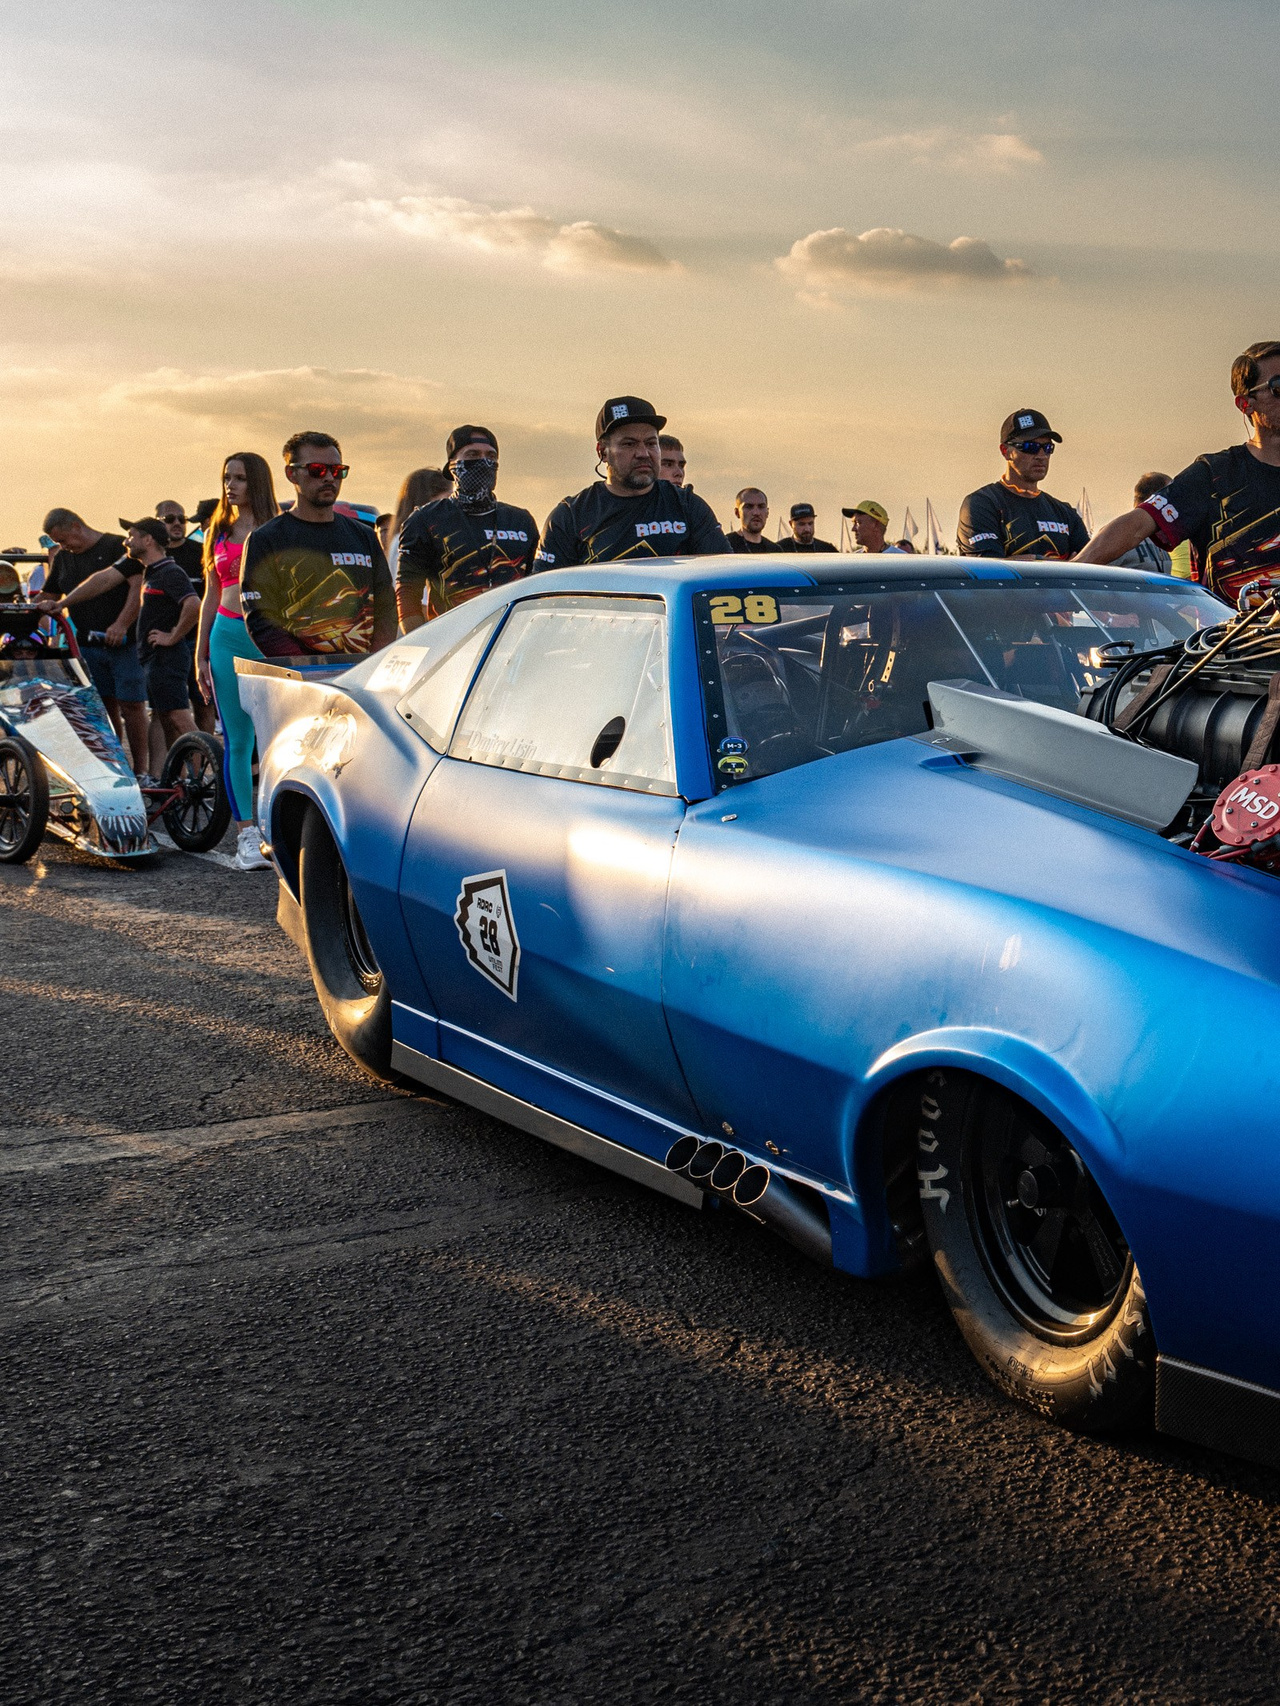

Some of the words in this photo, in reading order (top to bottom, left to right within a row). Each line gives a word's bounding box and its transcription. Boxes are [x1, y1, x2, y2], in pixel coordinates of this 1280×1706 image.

[635, 520, 686, 537] RDRC
[709, 595, 778, 624] 28
[1230, 786, 1280, 820] MSD
[477, 897, 493, 913] RDRC
[479, 915, 500, 956] 28
